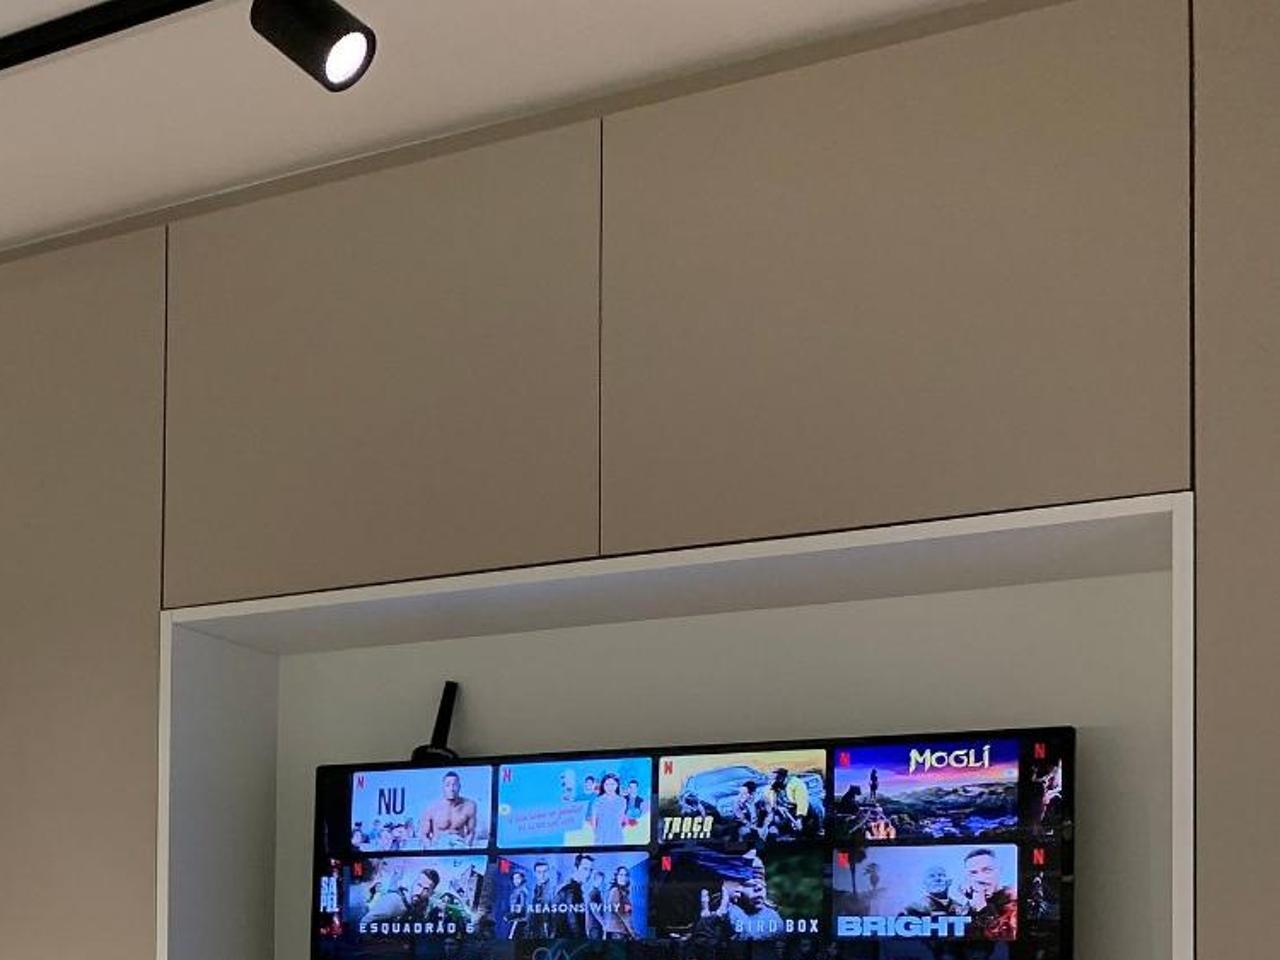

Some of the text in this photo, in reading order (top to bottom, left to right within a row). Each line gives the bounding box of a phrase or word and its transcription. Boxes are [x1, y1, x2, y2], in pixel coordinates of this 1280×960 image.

[378, 787, 405, 816] NU
[590, 902, 621, 914] WHY
[359, 919, 457, 935] ESQUADRÃO
[735, 918, 819, 933] BIRD BOX
[837, 915, 972, 938] BRIGHT
